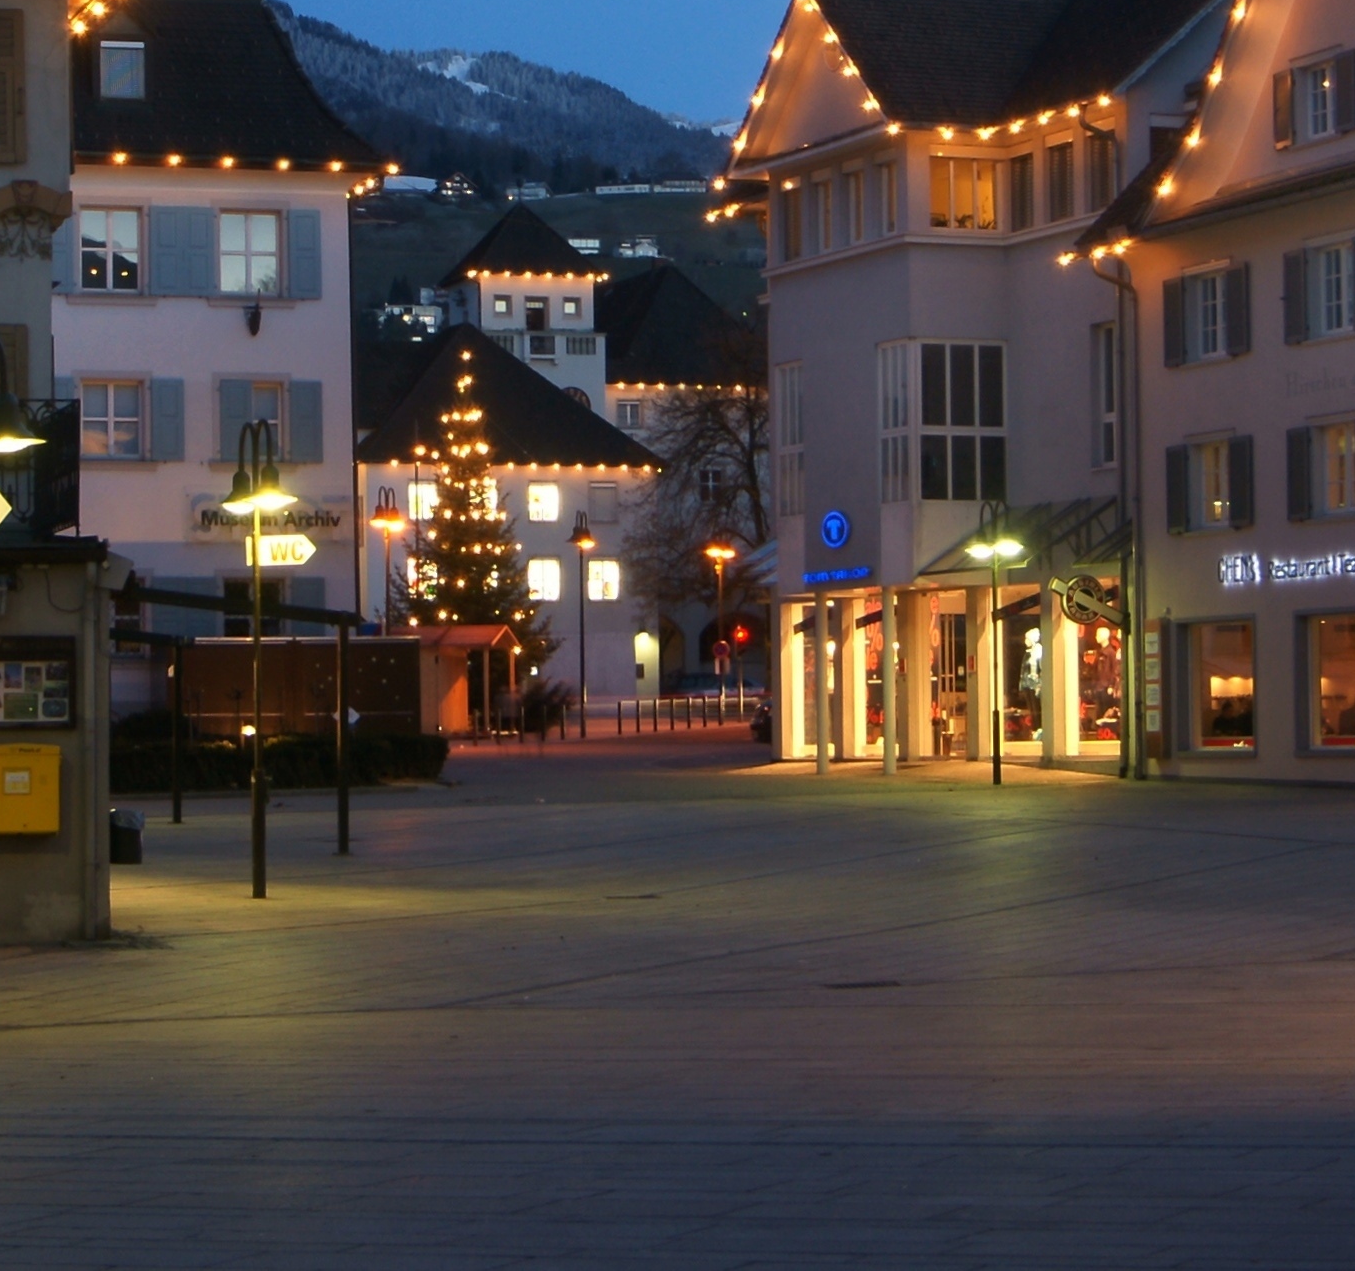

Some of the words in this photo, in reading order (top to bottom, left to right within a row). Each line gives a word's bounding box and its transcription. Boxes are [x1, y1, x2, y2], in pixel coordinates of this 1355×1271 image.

[284, 510, 342, 528] Archiv
[270, 541, 304, 561] WC
[1267, 558, 1330, 579] Restaurant
